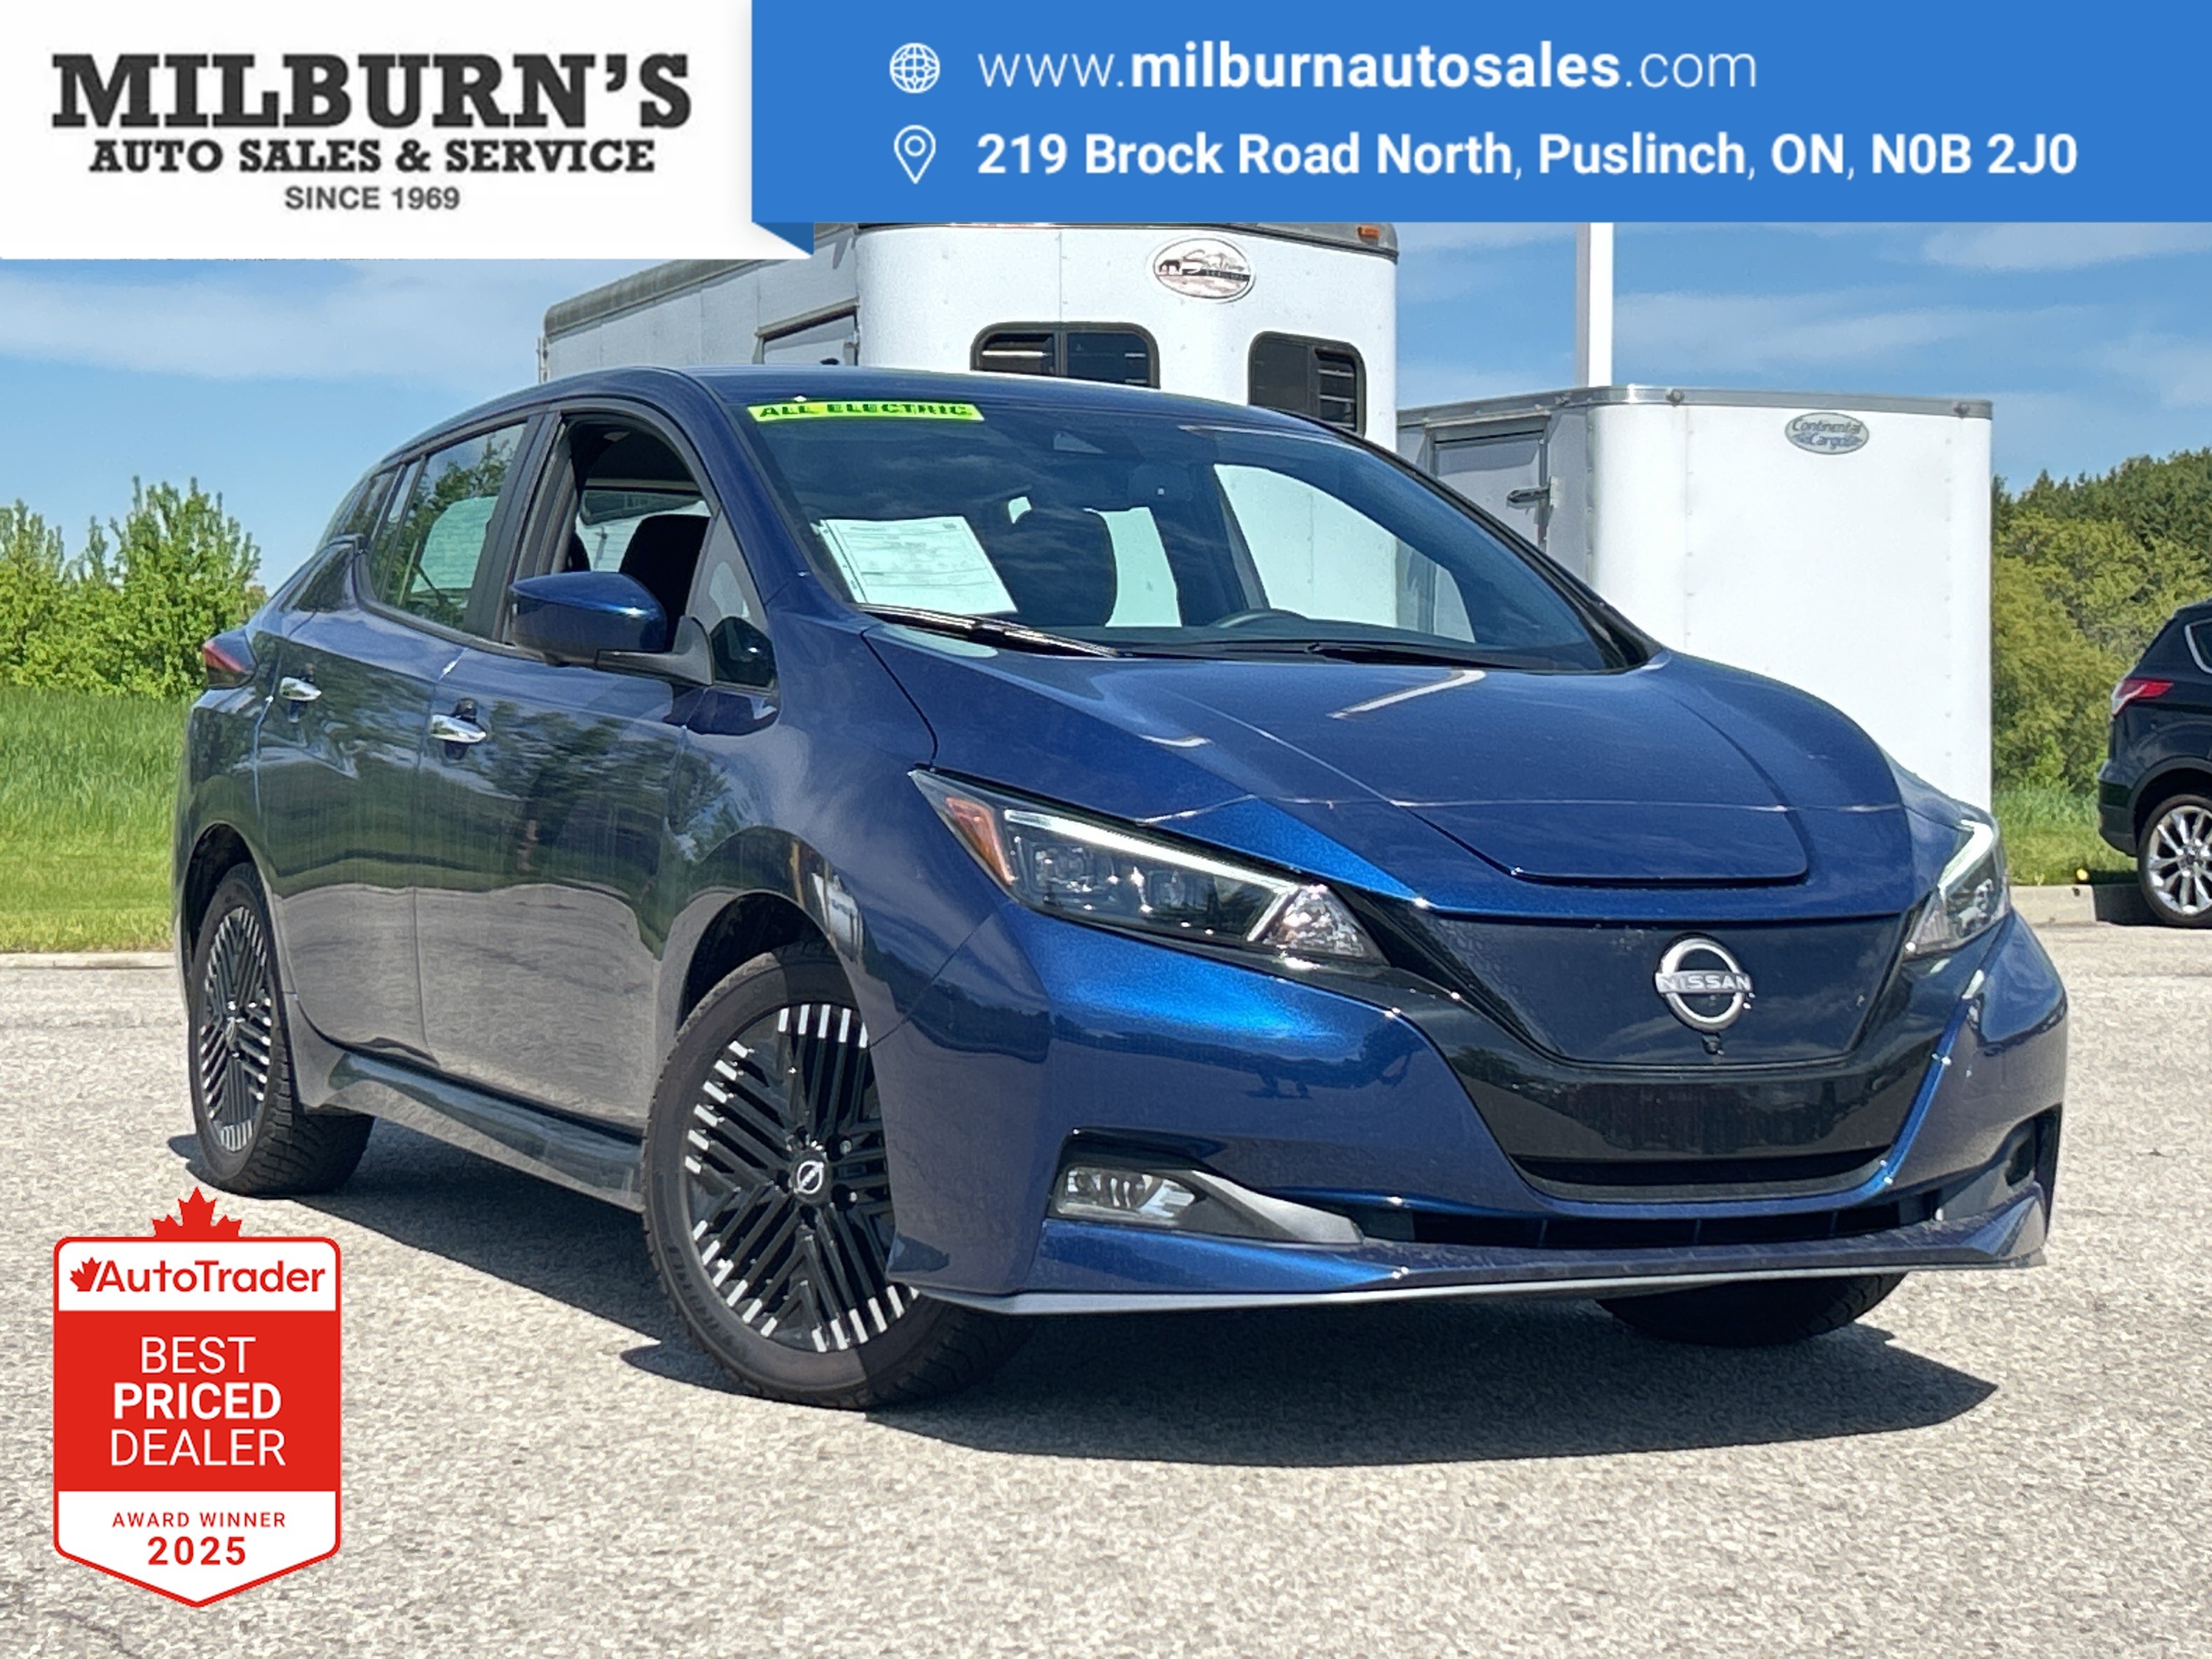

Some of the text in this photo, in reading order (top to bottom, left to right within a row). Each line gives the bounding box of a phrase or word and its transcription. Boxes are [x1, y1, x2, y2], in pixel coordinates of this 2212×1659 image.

[760, 403, 972, 417] ALL ELECTRIC
[1661, 975, 1751, 991] NISSAN
